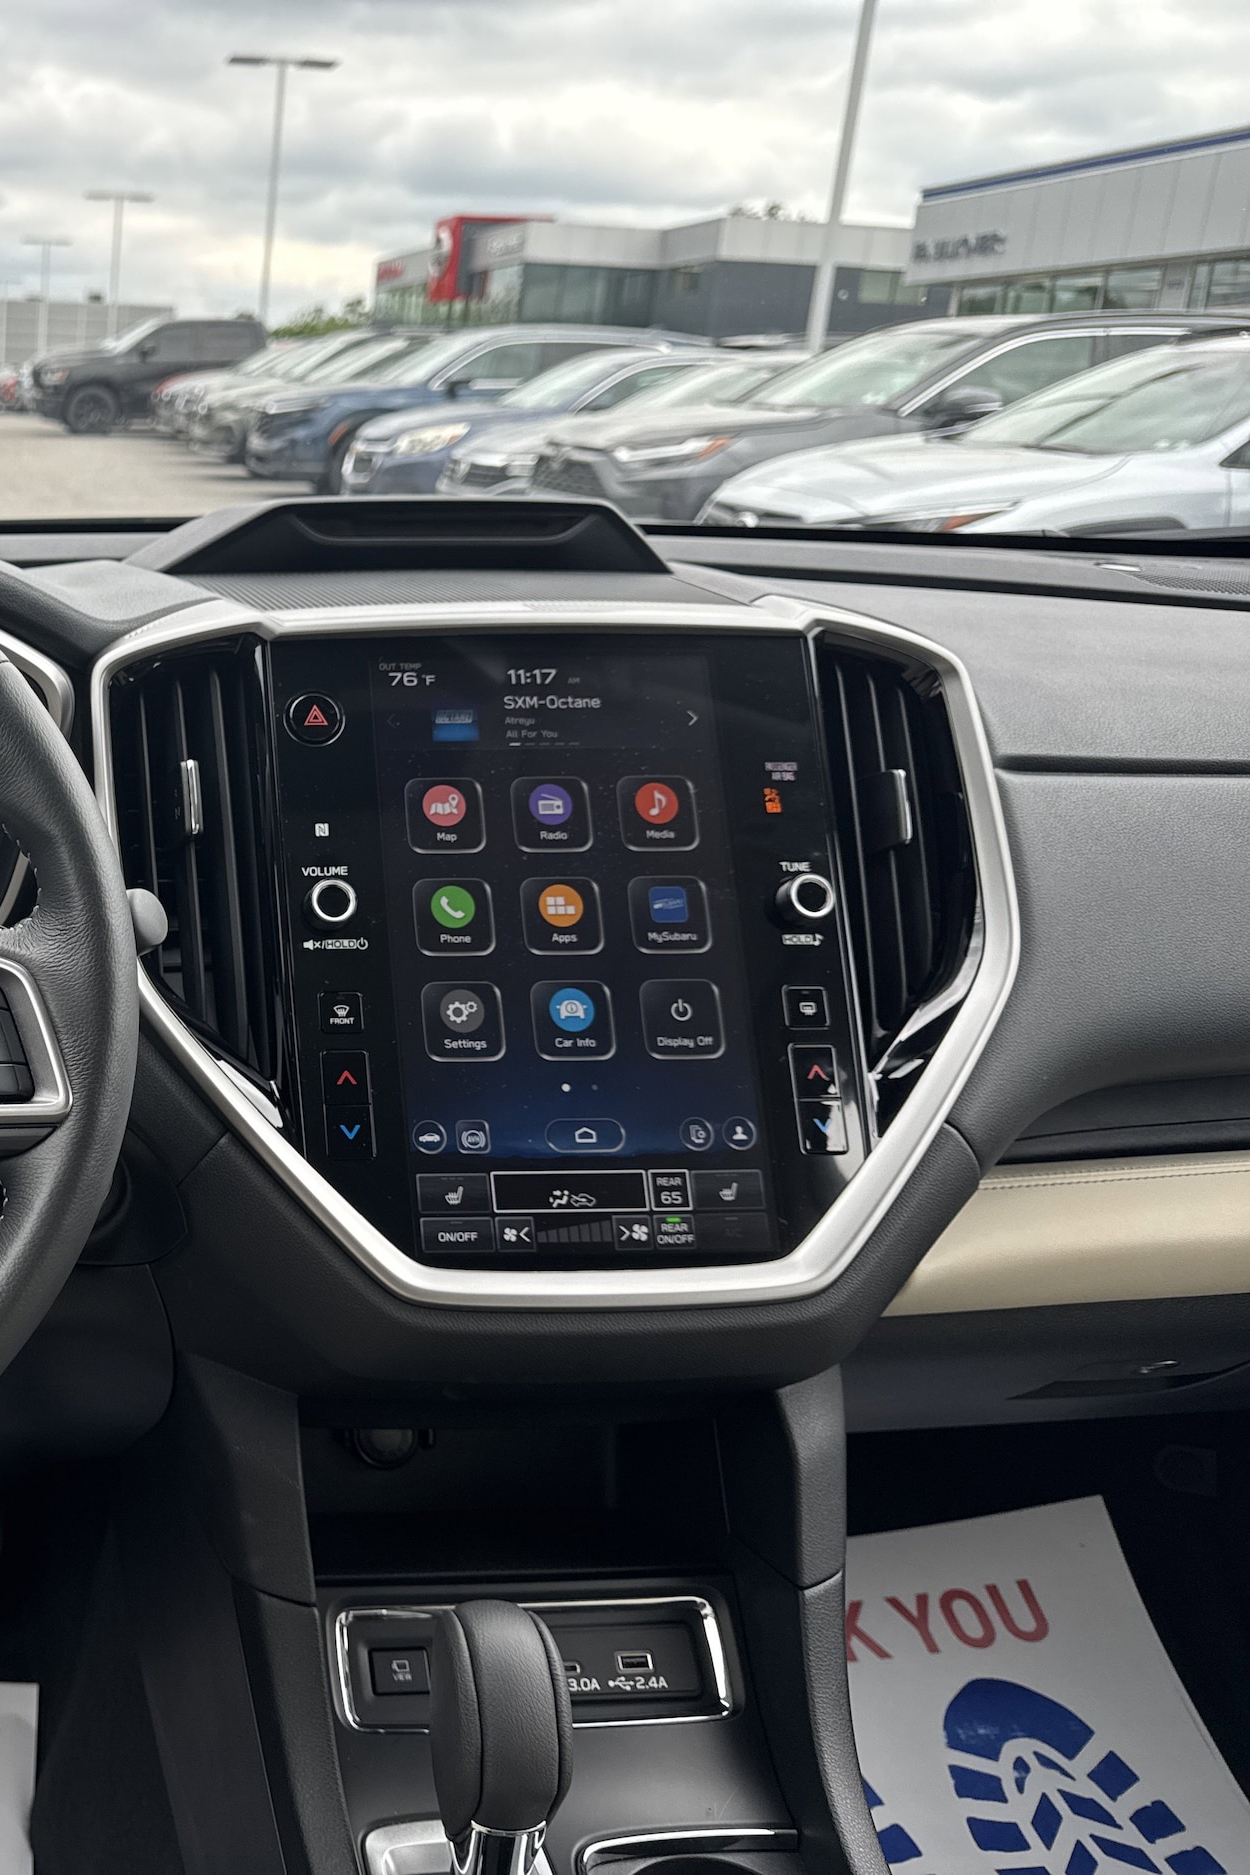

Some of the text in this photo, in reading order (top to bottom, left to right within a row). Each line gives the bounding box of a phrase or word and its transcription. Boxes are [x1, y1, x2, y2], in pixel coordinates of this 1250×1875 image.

[379, 663, 396, 671] OUT
[388, 672, 418, 686] 76
[507, 669, 557, 685] 11:17
[503, 695, 601, 709] SXM-Octane
[505, 716, 535, 726] Atreyu
[506, 730, 558, 738] All For You
[437, 832, 457, 843] Map
[540, 830, 568, 841] Radio
[646, 829, 675, 840] Media
[301, 866, 349, 877] VOLUME
[779, 862, 811, 872] TUNE
[440, 934, 472, 944] Phone
[552, 933, 577, 943] Apps
[648, 932, 697, 943] MySubaru
[782, 934, 813, 945] HOLD
[327, 939, 356, 949] HOLD
[330, 1017, 354, 1025] FRONT
[444, 1038, 487, 1050] Settings
[554, 1038, 596, 1048] Car Info
[657, 1036, 713, 1048] Display Off
[656, 1177, 681, 1187] REAR
[660, 1191, 682, 1204] 65
[660, 1223, 688, 1233] REAR
[437, 1231, 478, 1243] ON/OFF
[657, 1234, 695, 1245] ON/OFF
[884, 1578, 1049, 1654] YOU
[568, 1676, 668, 1692] 3.0A 2.4A
